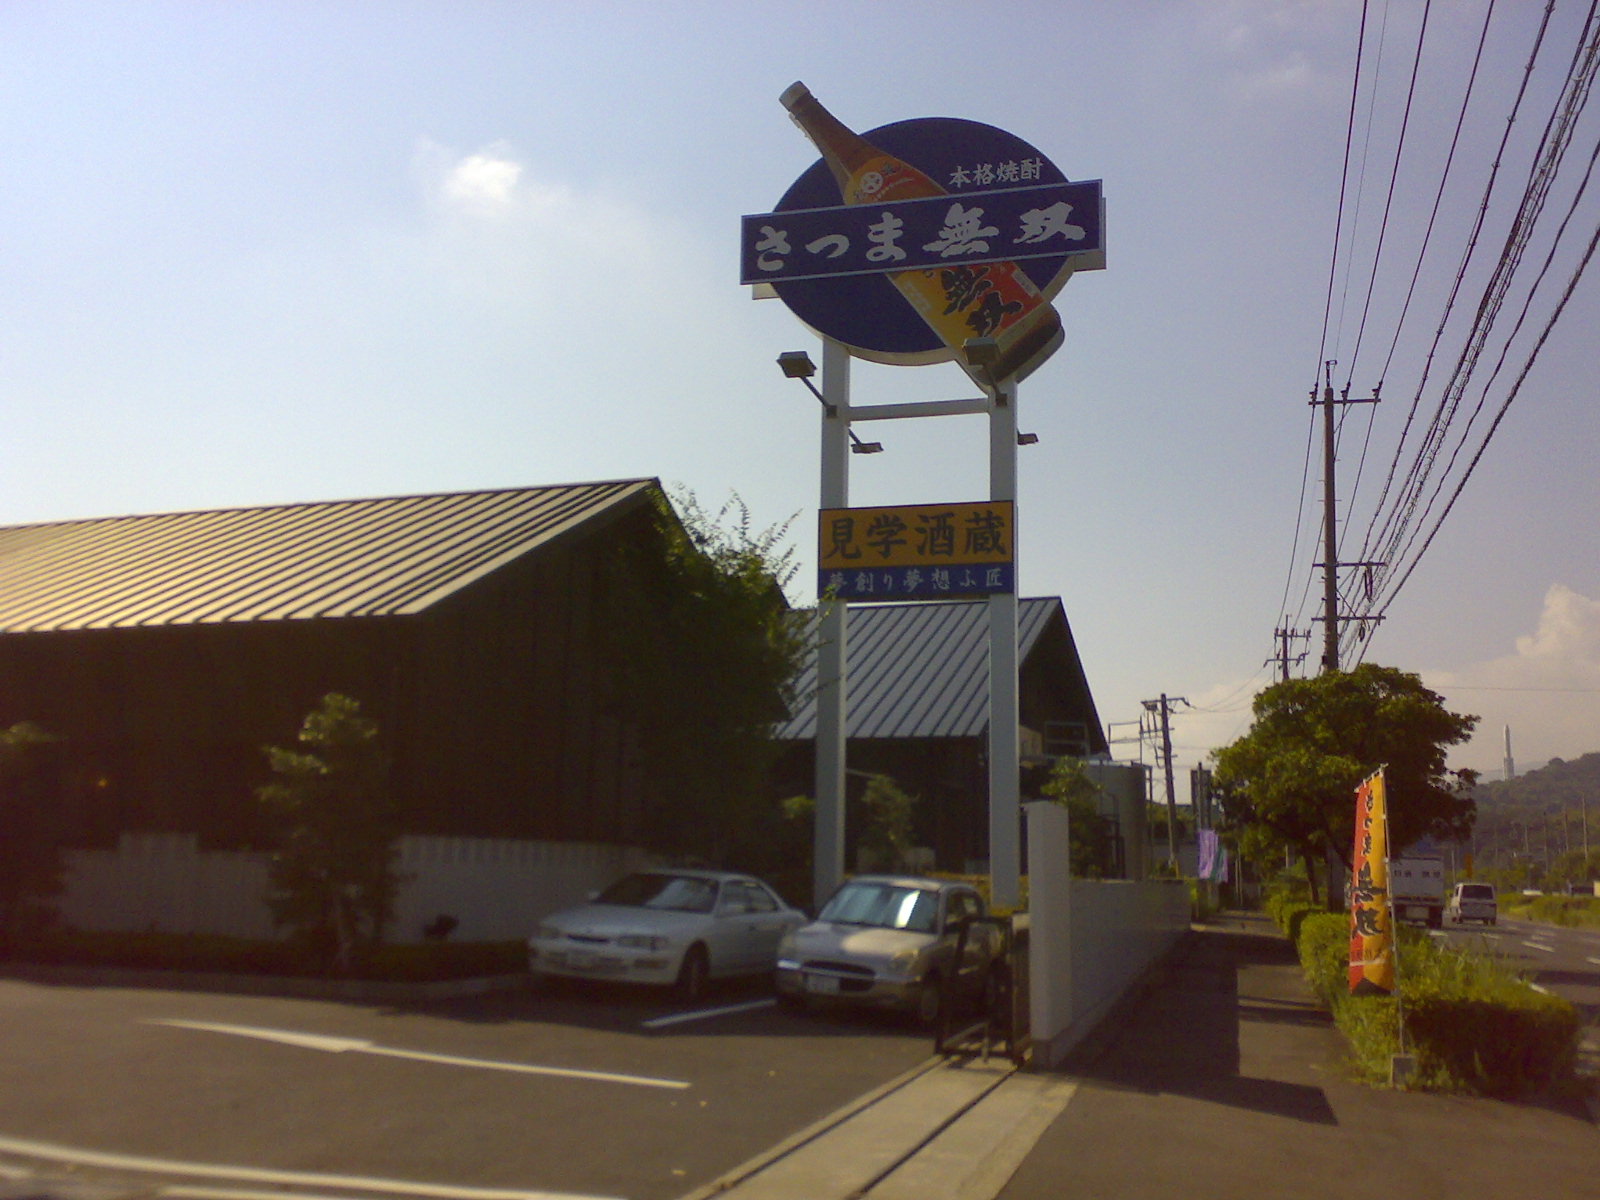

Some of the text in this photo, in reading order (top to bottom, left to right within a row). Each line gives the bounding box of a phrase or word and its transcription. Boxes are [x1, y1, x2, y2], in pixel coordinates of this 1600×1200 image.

[949, 157, 1043, 188] 本格焼酎
[754, 202, 1086, 271] さつま無双
[824, 510, 1007, 559] 見学酒蔵
